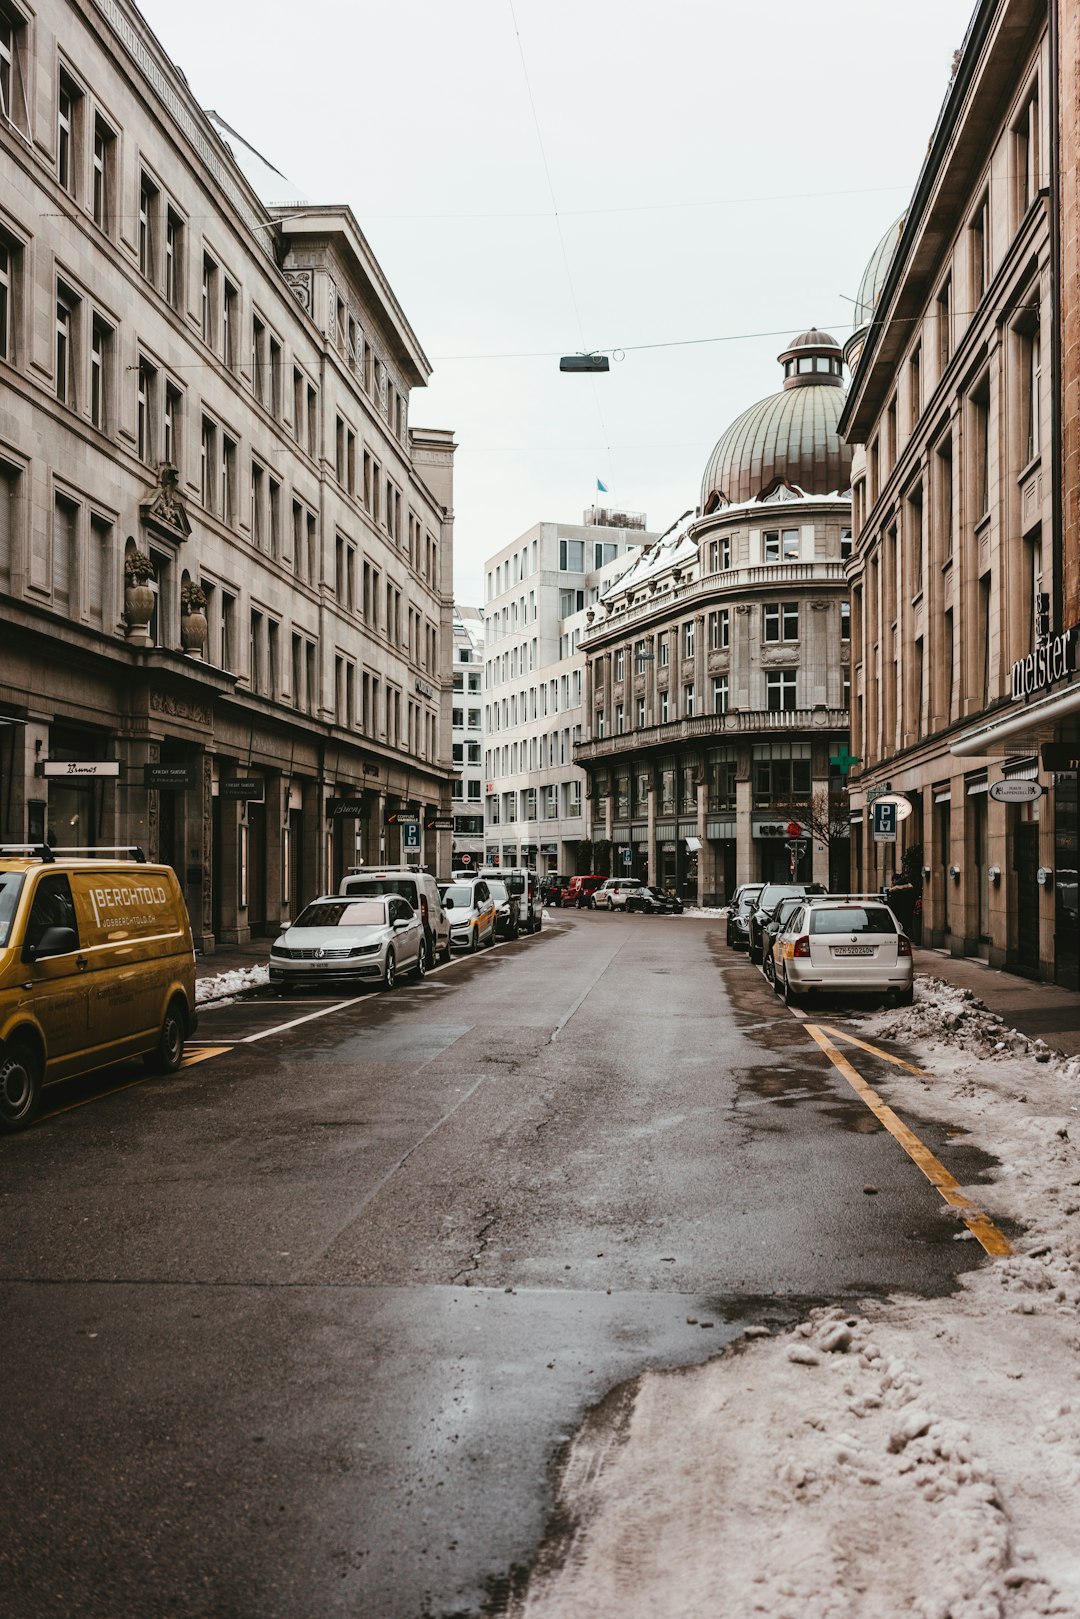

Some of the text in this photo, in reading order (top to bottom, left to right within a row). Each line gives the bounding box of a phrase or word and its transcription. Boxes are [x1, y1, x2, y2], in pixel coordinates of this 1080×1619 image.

[1011, 629, 1071, 700] meister
[67, 763, 97, 773] Brunos
[881, 805, 891, 820] P
[408, 825, 417, 837] P
[95, 887, 166, 907] BERCHTOLD
